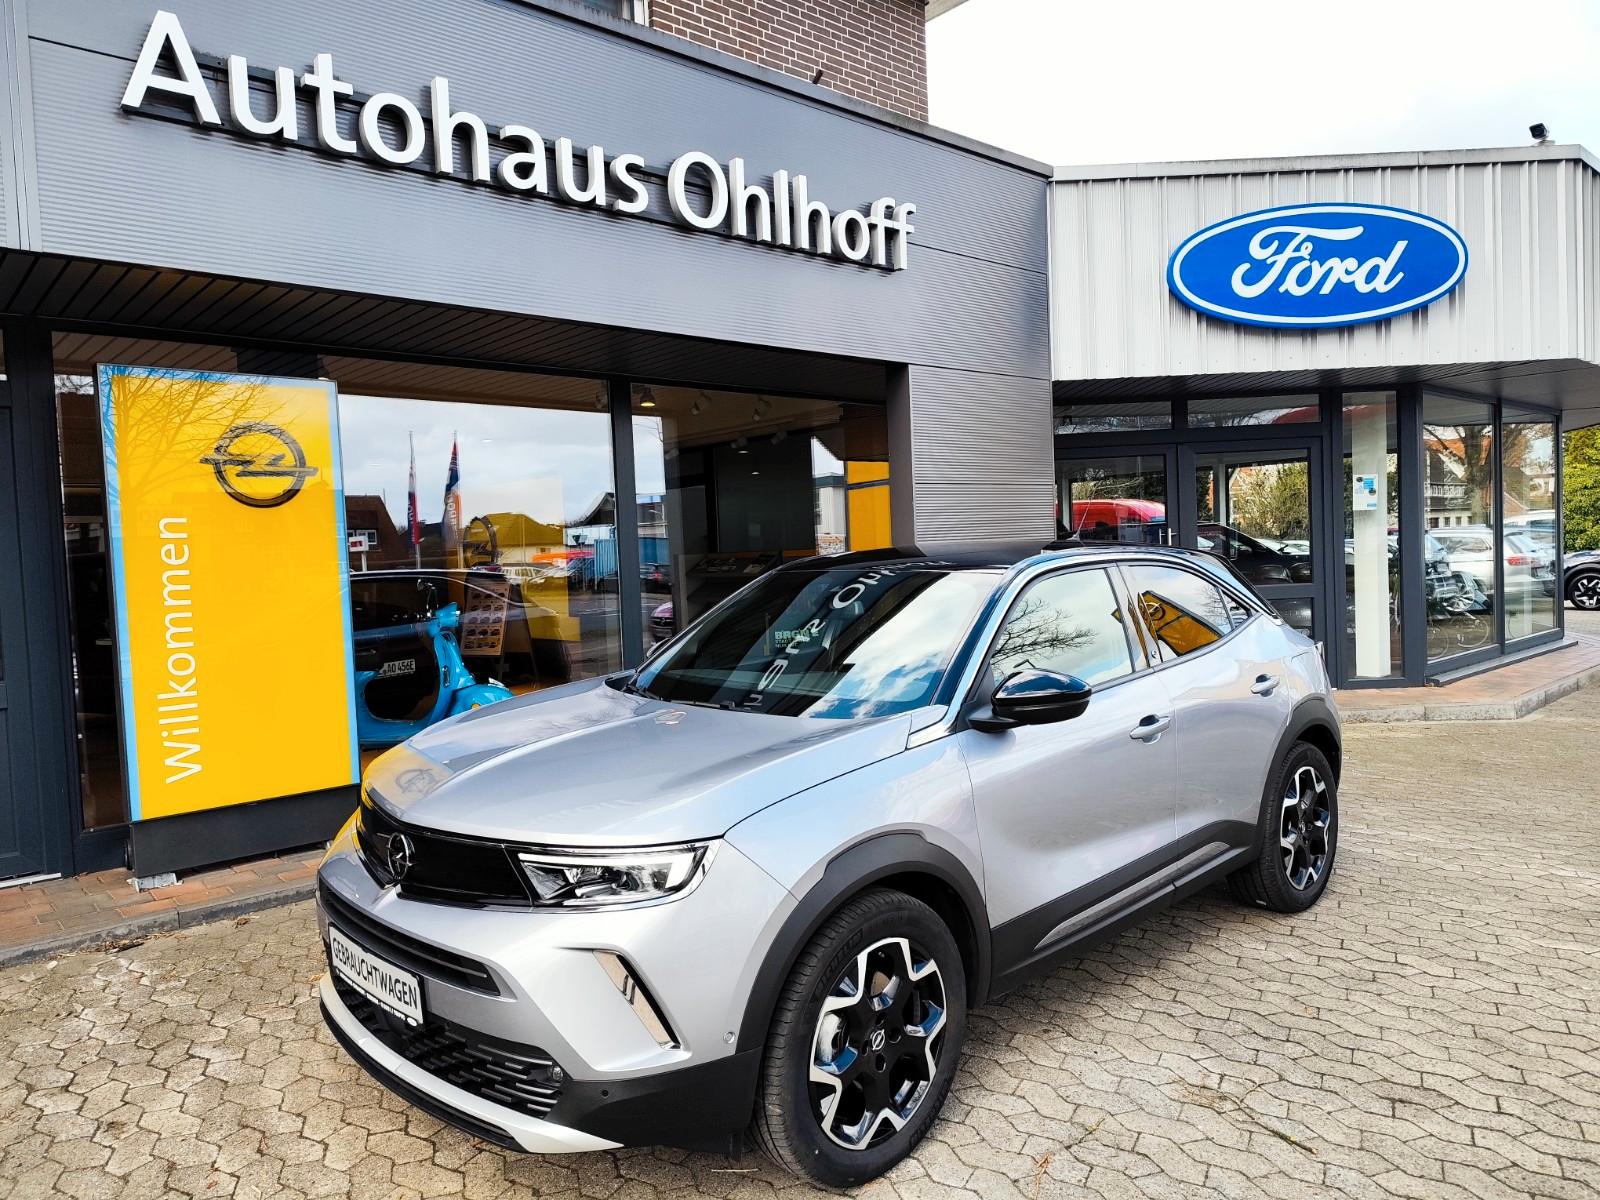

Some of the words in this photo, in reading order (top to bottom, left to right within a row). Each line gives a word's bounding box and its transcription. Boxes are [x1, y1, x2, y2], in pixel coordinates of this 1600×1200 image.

[119, 9, 650, 214] Autohaus
[667, 151, 917, 271] Ohlhoff
[1231, 225, 1409, 299] Ford
[156, 516, 203, 785] Willkommen
[332, 937, 418, 1010] GEBRAUCHTWAGEN
